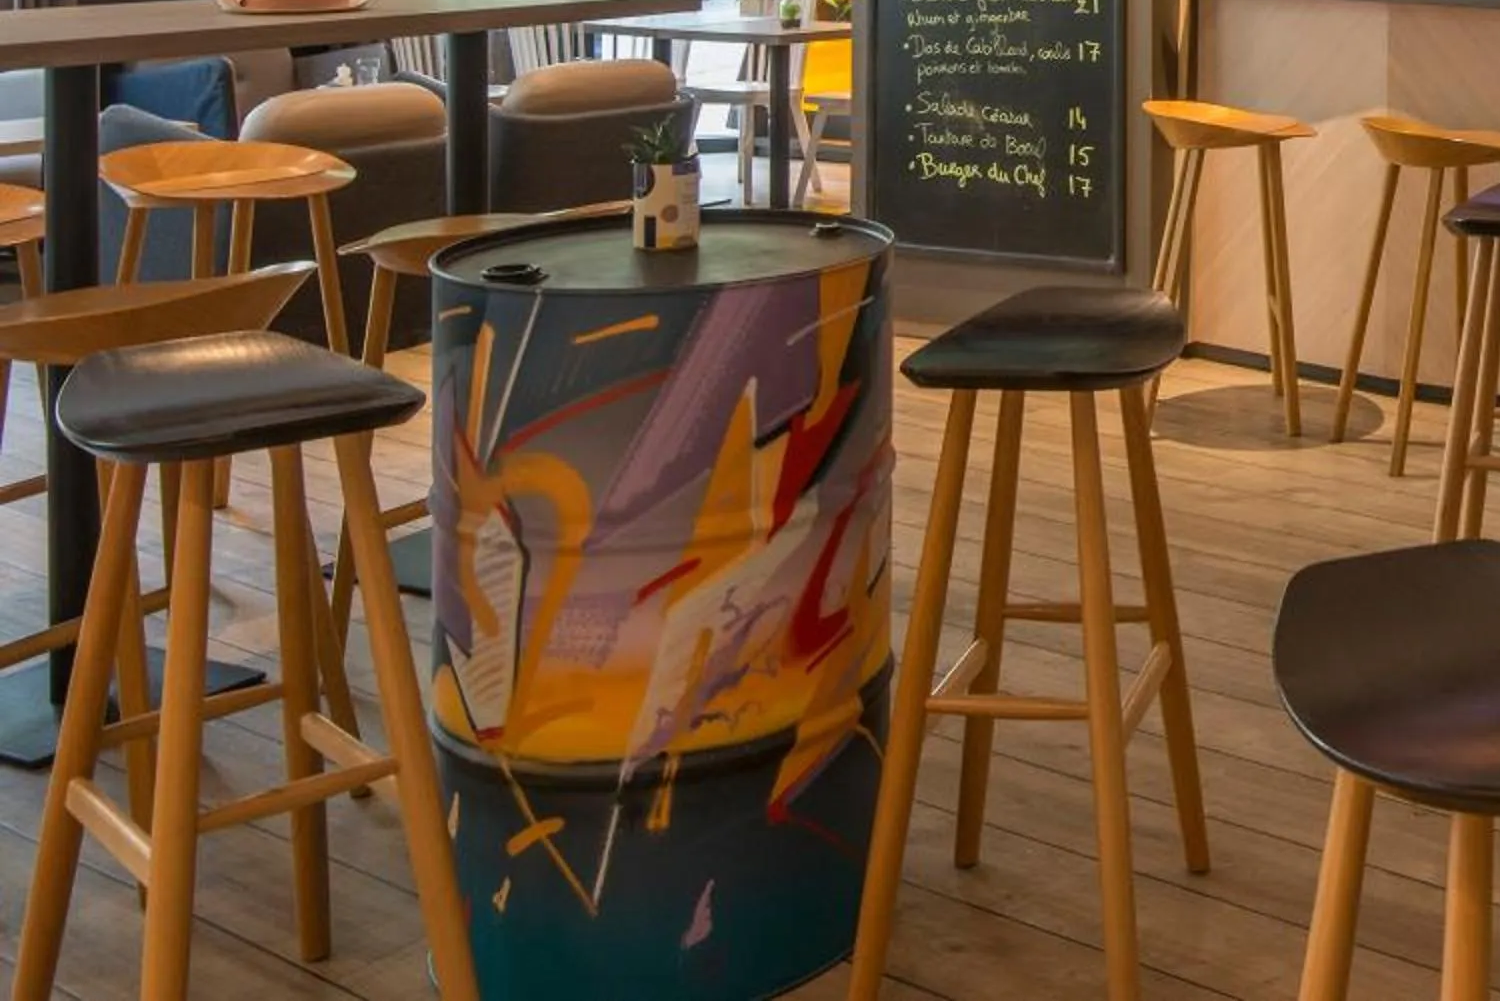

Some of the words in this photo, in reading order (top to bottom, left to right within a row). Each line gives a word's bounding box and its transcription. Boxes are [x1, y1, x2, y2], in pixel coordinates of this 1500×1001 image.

[1078, 40, 1101, 63] 17
[1069, 106, 1087, 130] 14
[1069, 145, 1095, 167] 15
[915, 152, 983, 187] Burger
[987, 162, 1010, 184] du
[1069, 176, 1092, 197] 17
